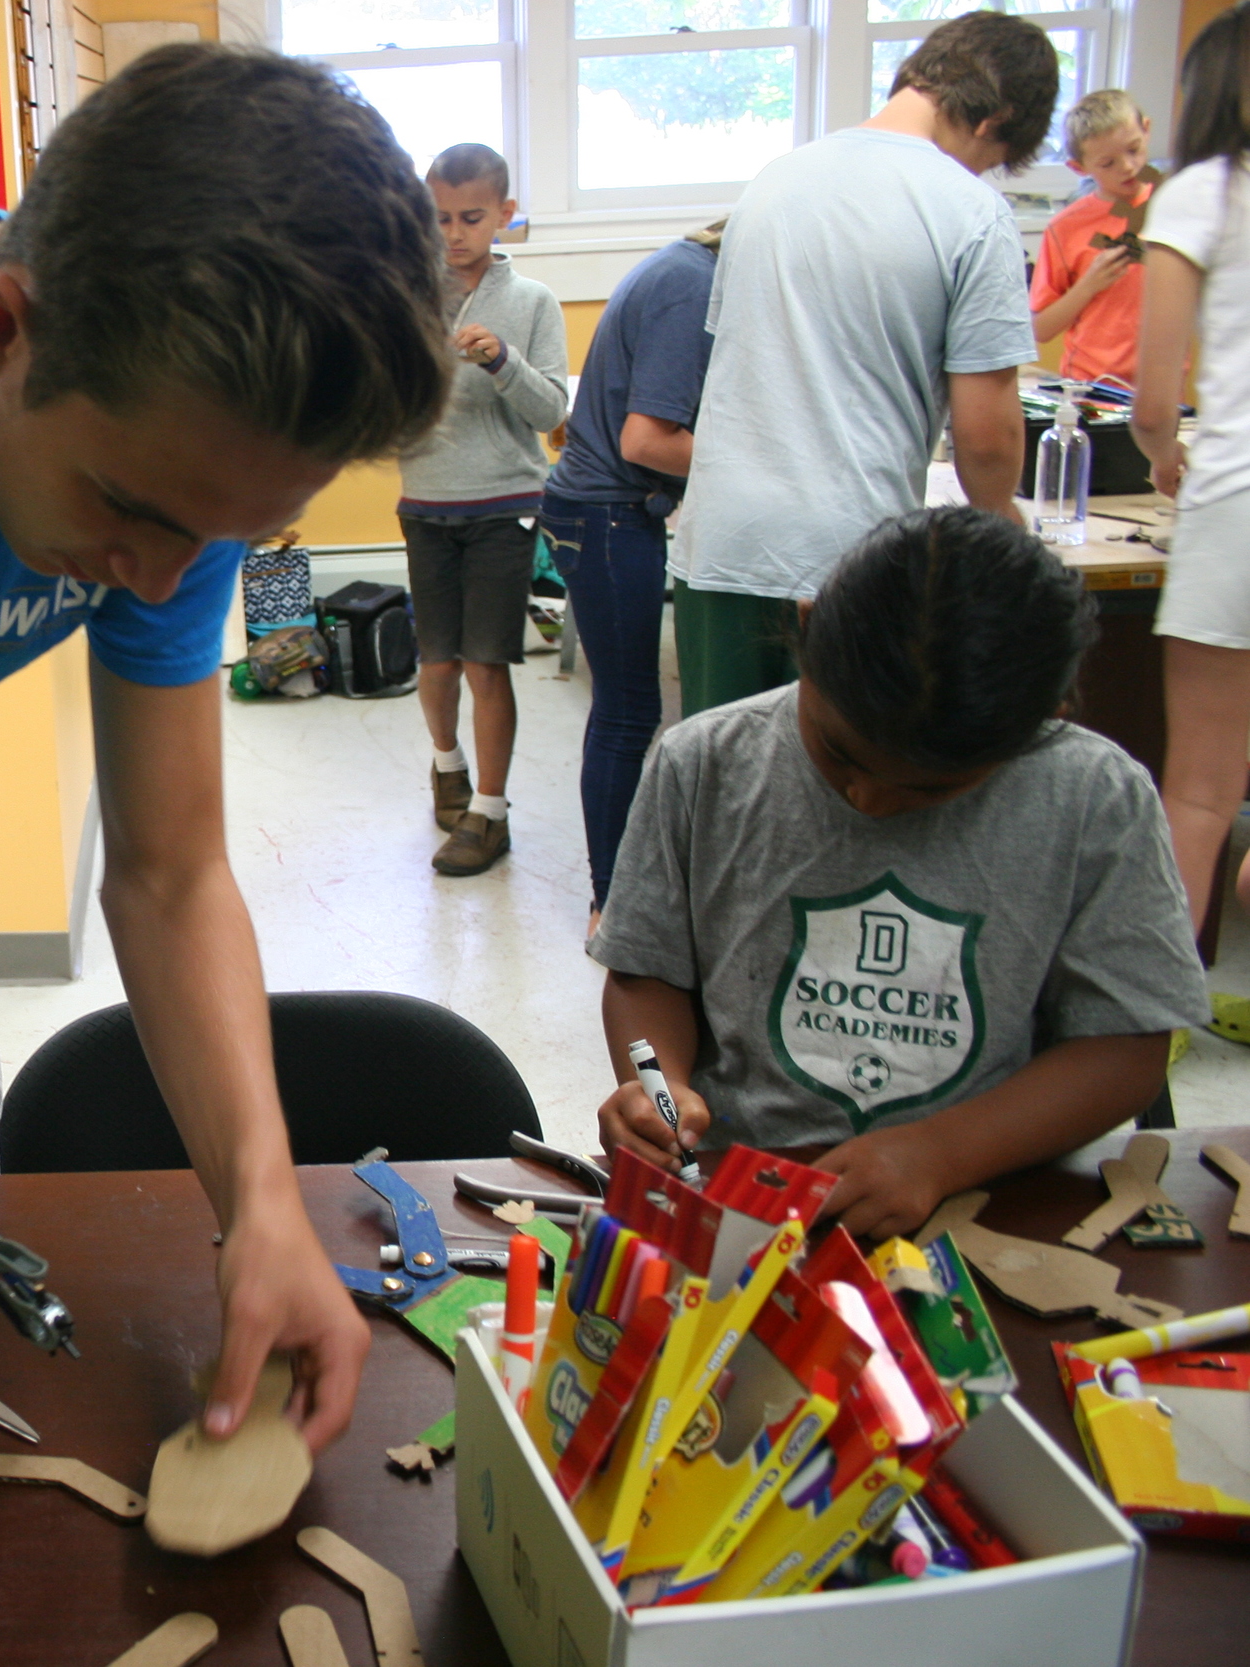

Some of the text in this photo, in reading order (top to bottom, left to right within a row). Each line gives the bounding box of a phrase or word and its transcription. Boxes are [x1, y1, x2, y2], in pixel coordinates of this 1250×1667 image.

[856, 911, 909, 976] D
[796, 976, 961, 1022] SOCCER
[796, 1010, 958, 1048] ACADEMIES
[734, 1468, 780, 1523] Classic
